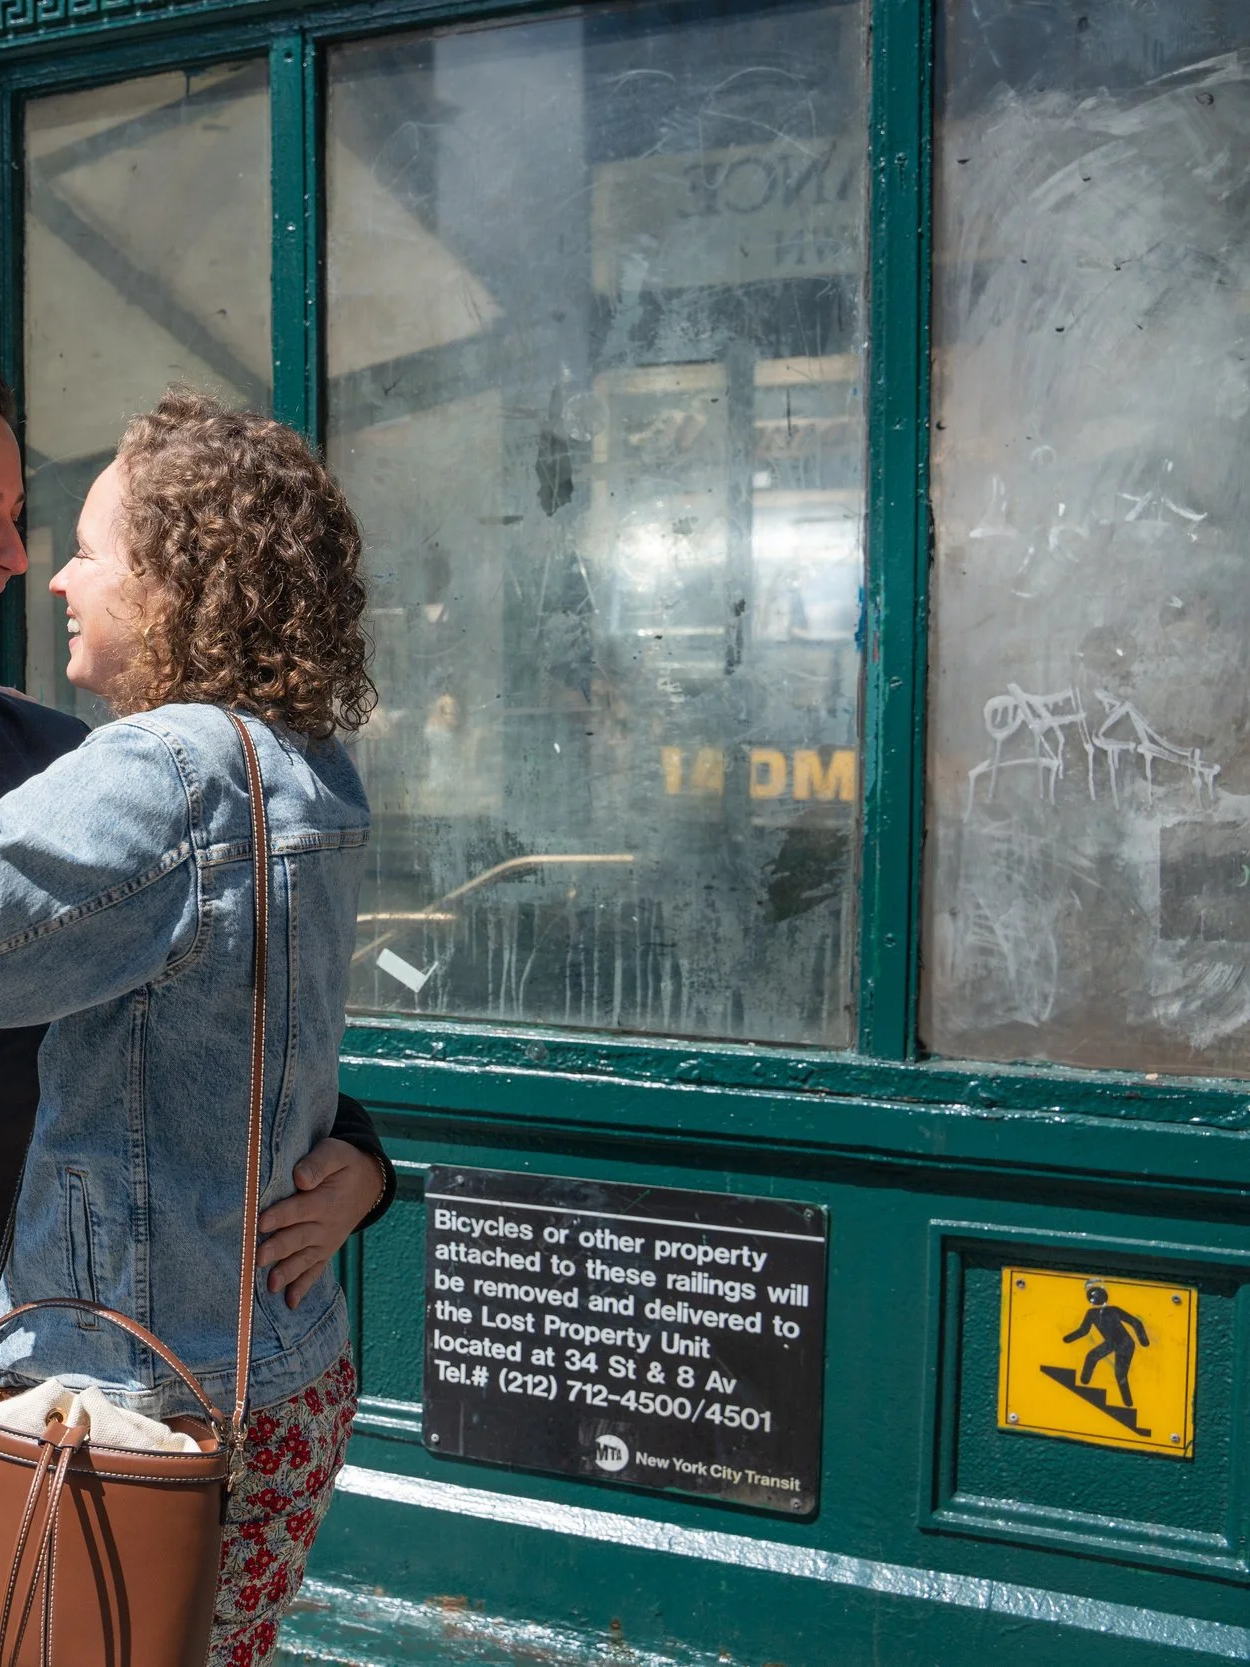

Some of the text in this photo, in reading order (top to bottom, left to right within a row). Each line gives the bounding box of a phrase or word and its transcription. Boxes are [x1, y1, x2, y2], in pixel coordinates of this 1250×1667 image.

[435, 1209, 767, 1276] Bicycles or other property
[435, 1242, 808, 1307] attached to these railings will
[435, 1269, 800, 1338] be removed and delivered to
[435, 1300, 710, 1358] the Lost Property Unit
[434, 1329, 736, 1394] located at 34 St & 8 Av
[434, 1359, 771, 1432] Tel.# (212) 712-4500/4501
[636, 1451, 670, 1469] New
[672, 1457, 707, 1475] York
[710, 1464, 742, 1484] City
[745, 1470, 800, 1491] Transit
